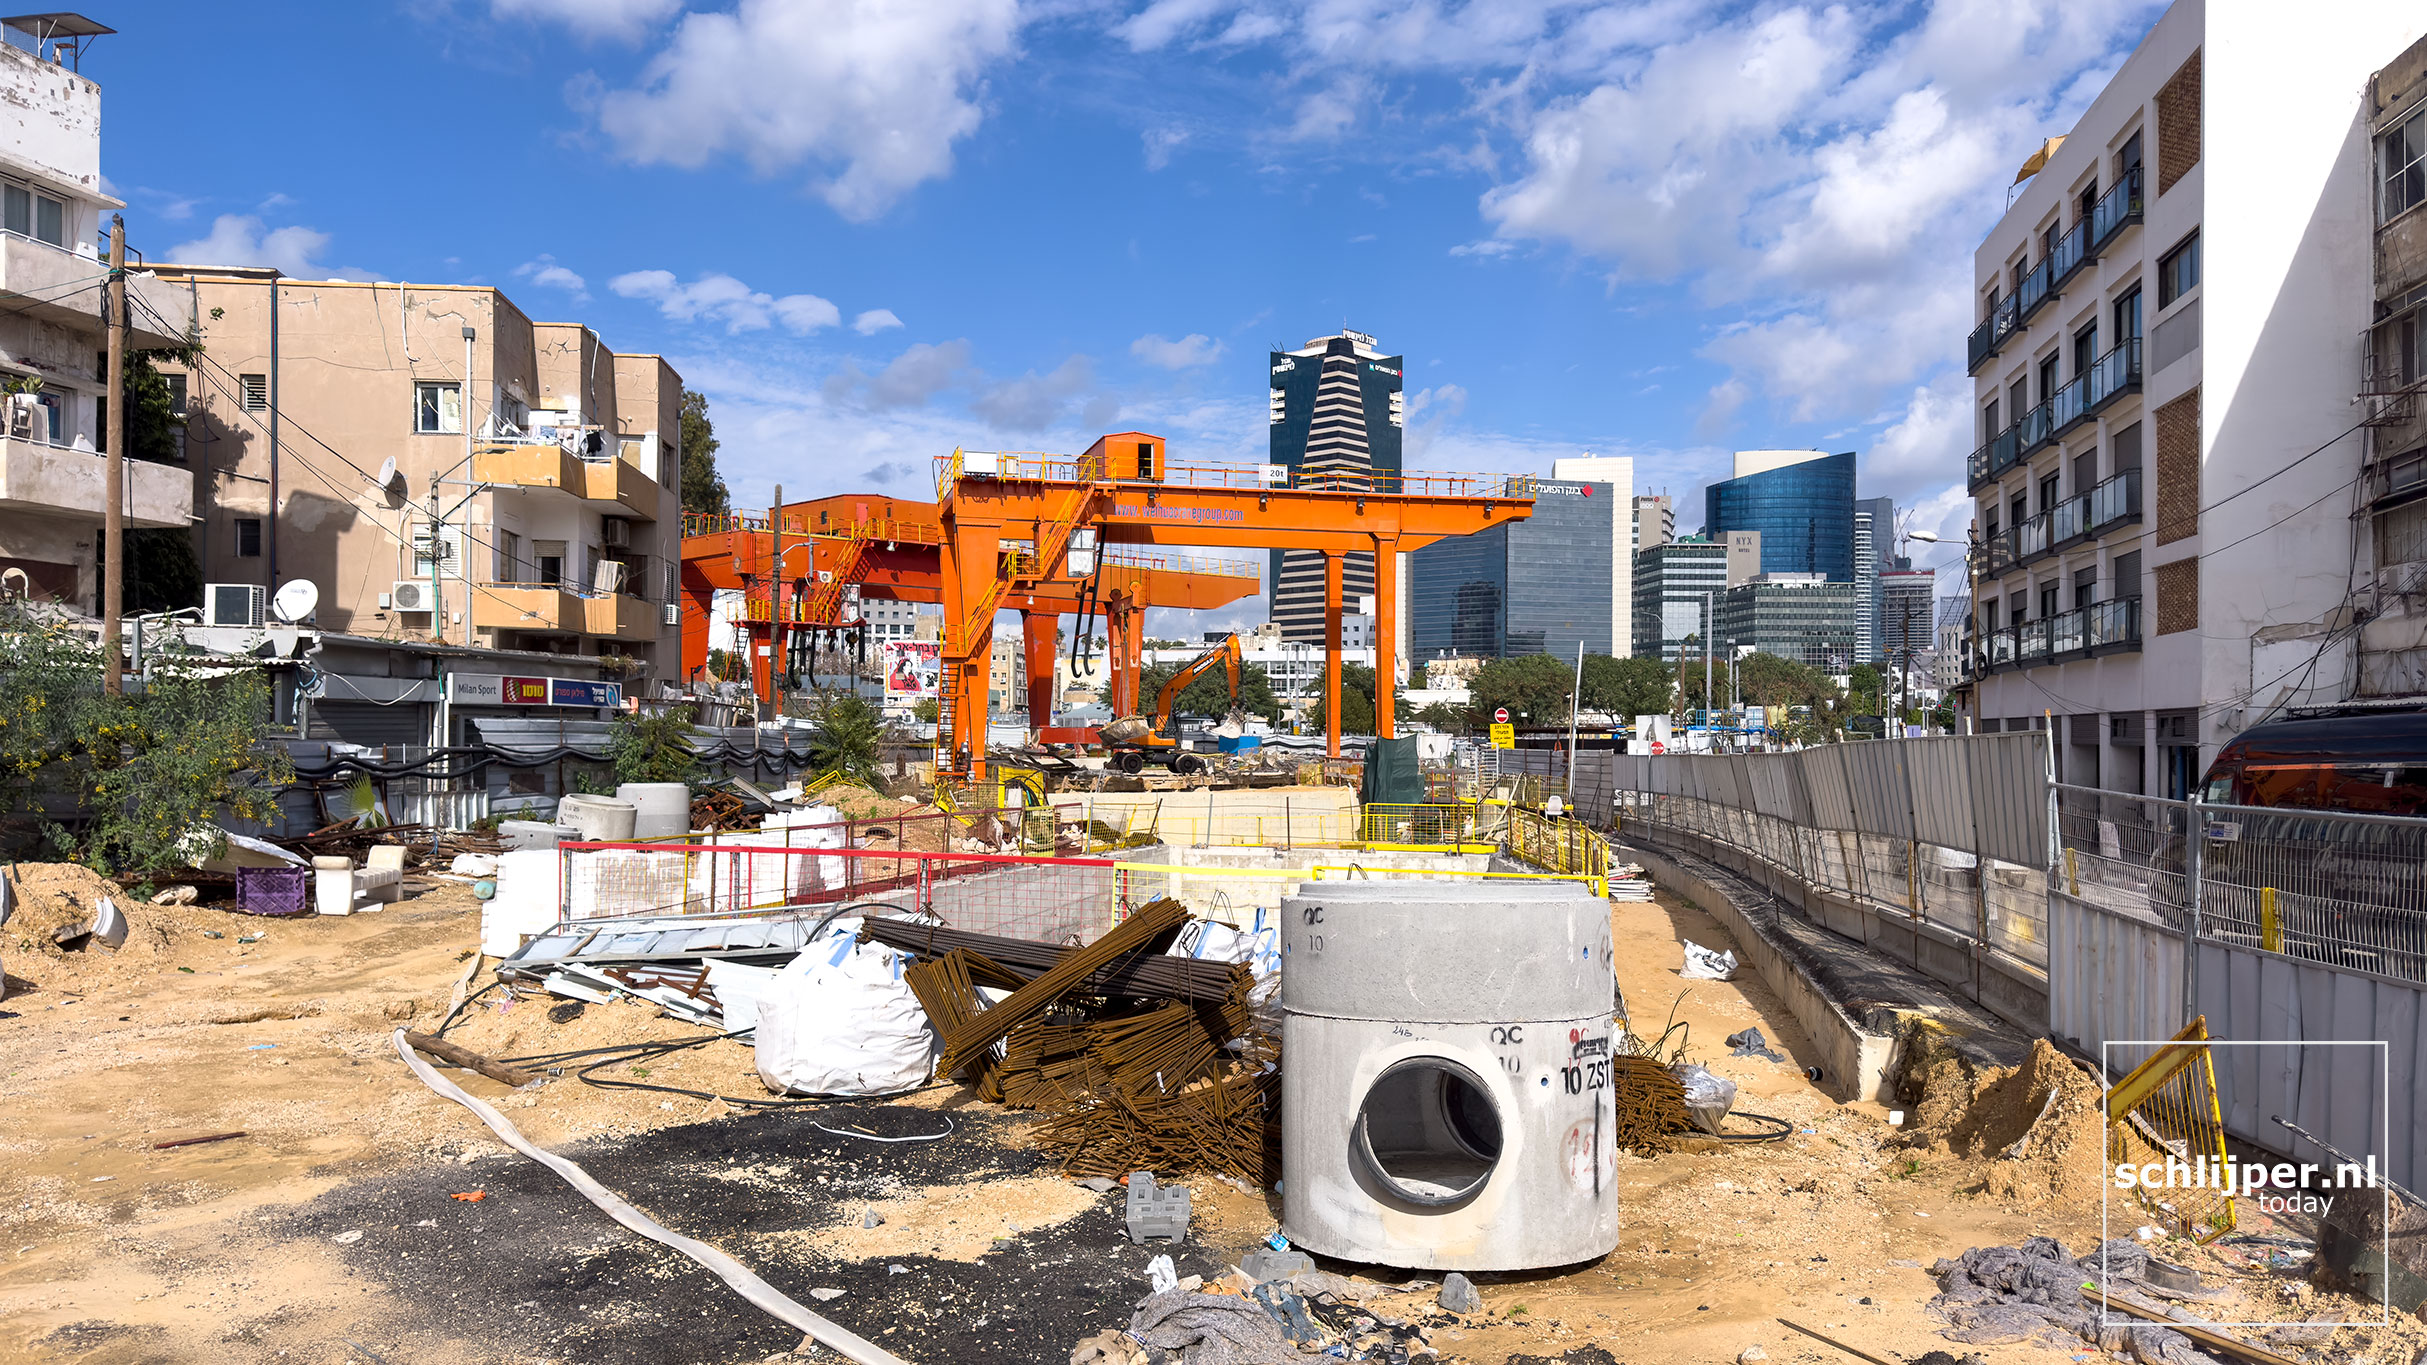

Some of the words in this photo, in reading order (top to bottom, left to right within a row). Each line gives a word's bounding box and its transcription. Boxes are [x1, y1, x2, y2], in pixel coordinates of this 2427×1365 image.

[1270, 469, 1284, 477] 20t
[1528, 482, 1564, 494] הפועלים
[1565, 486, 1581, 496] בנק
[1736, 536, 1752, 545] NYX
[458, 683, 478, 694] Milan
[478, 685, 497, 697] Sport
[522, 684, 544, 698] טוטו
[1304, 906, 1324, 925] QC
[1309, 935, 1324, 951] 10
[1490, 1025, 1524, 1045] QC
[1561, 1066, 1582, 1096] 10
